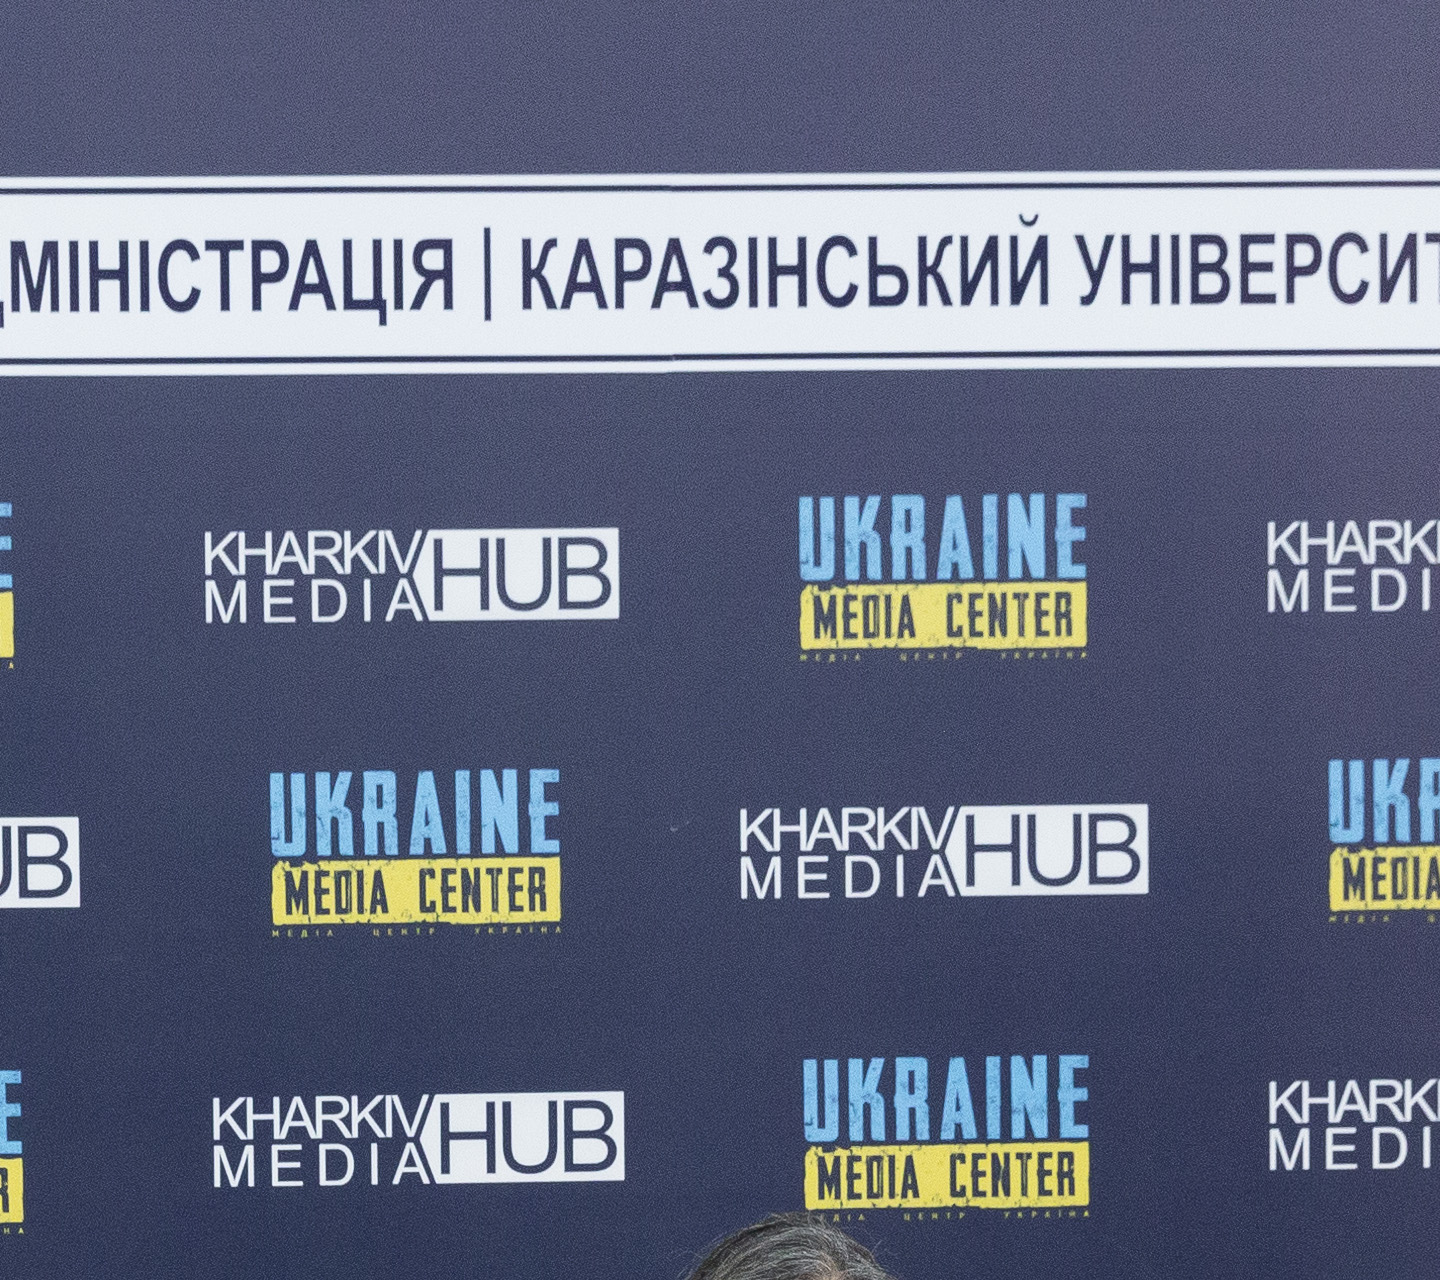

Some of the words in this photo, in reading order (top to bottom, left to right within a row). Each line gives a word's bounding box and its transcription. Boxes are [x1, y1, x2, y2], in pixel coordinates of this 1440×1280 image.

[522, 215, 1048, 310] КАРАЗІНСЬКИЙ
[205, 530, 422, 575] KHARKIV
[798, 492, 1087, 581] UKRAINE
[434, 537, 611, 611] HUB
[205, 578, 423, 623] MEDIA
[813, 593, 916, 639] MEDIA
[947, 592, 1072, 638] CENTER
[269, 768, 560, 857] UKRAINE
[740, 806, 954, 852] KHARKIV
[966, 813, 1140, 886] HUB
[283, 869, 388, 915] MEDIA
[419, 867, 546, 913] CENTER
[741, 854, 955, 899] MEDIA
[213, 1094, 429, 1140] KHARKIV
[803, 1054, 1089, 1142] UKRAINE
[440, 1100, 617, 1174] HUB
[214, 1142, 430, 1187] MEDIA
[817, 1153, 919, 1200] MEDIA
[950, 1151, 1075, 1198] CENTER
